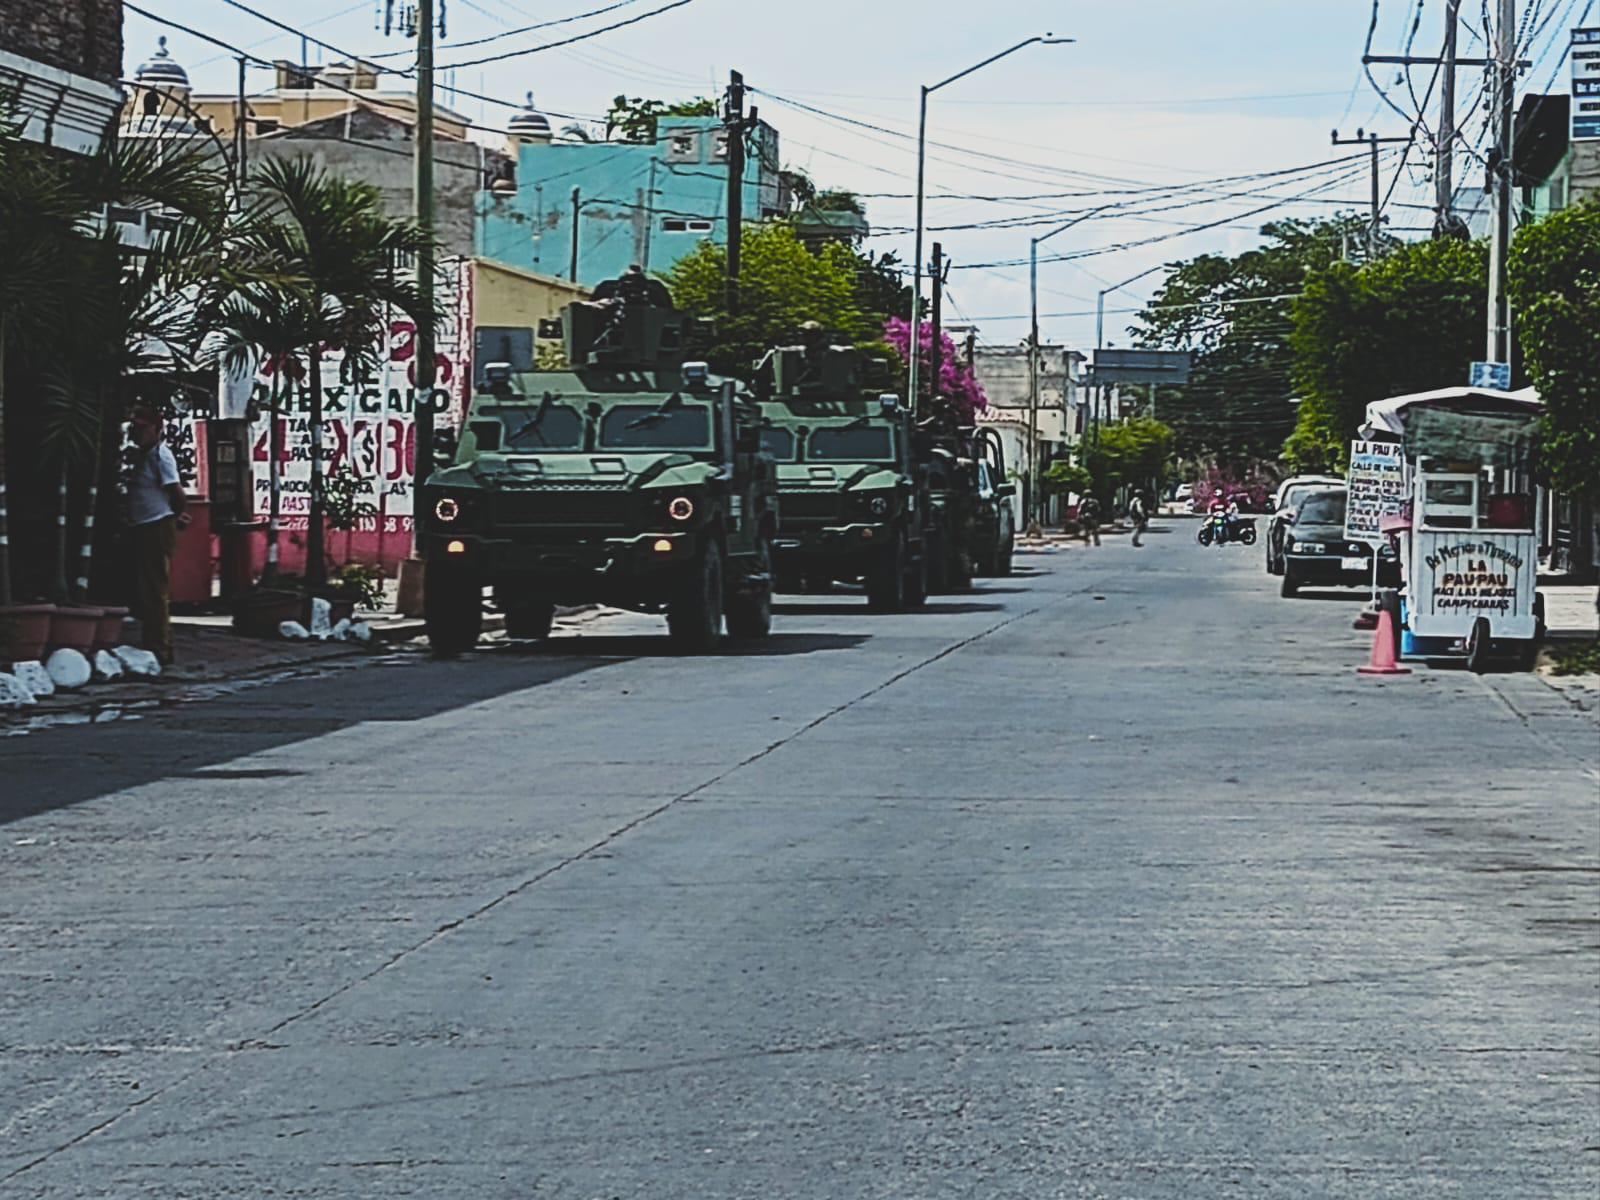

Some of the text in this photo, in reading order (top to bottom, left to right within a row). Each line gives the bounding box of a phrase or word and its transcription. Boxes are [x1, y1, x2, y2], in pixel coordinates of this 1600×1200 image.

[273, 387, 450, 413] MEXCAO
[288, 418, 332, 432] TAS
[290, 446, 336, 462] PASOR
[1355, 442, 1367, 454] LA
[1467, 559, 1488, 572] LA
[1458, 587, 1478, 597] LAS
